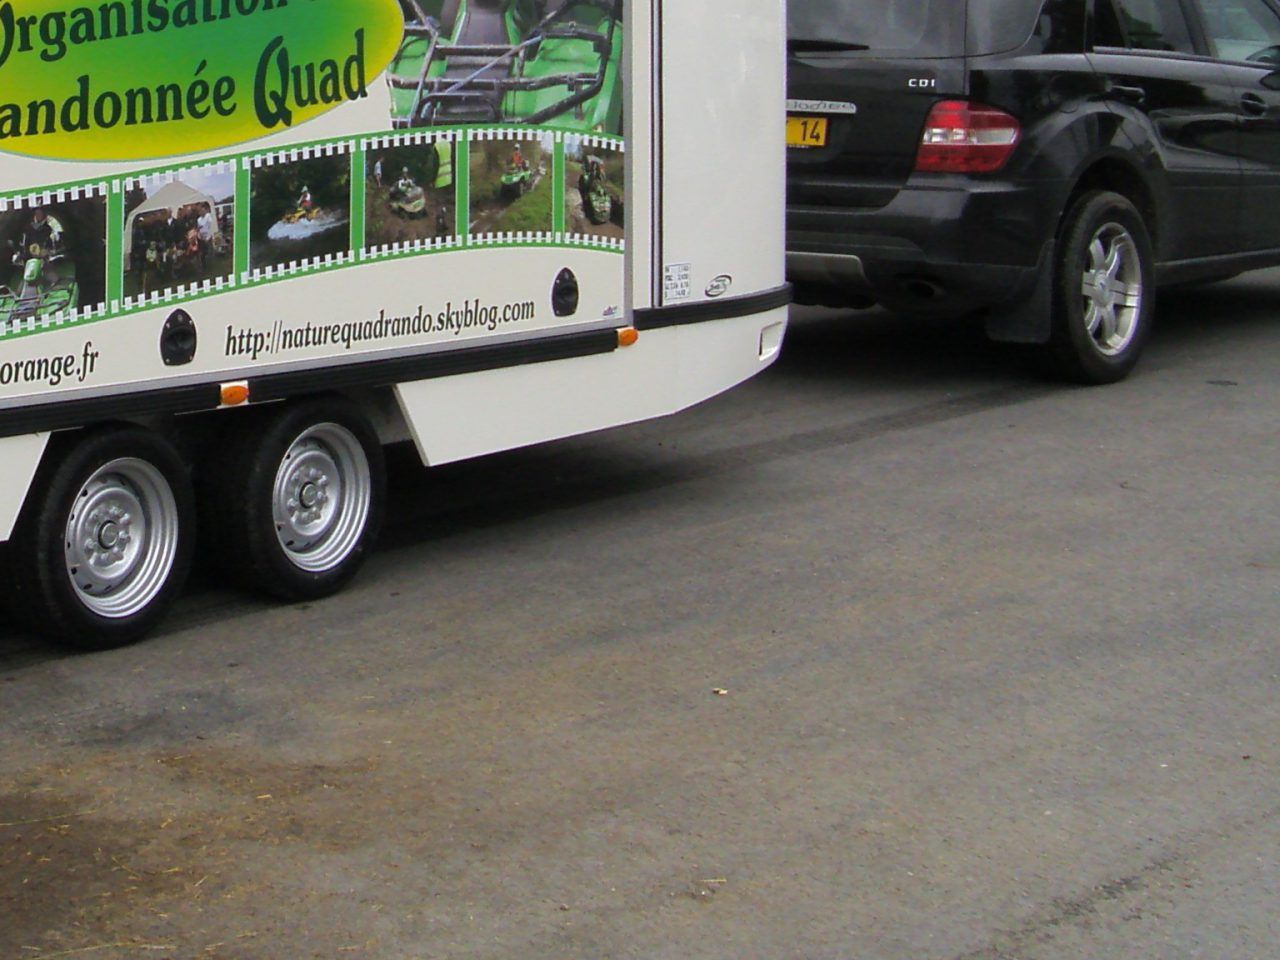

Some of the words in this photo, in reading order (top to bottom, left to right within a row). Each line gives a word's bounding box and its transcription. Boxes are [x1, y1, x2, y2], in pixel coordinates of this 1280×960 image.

[253, 28, 369, 129] Quad
[908, 78, 936, 88] CDI
[800, 120, 821, 143] 14
[224, 299, 535, 360] http://naturequadrando.skyblog.com
